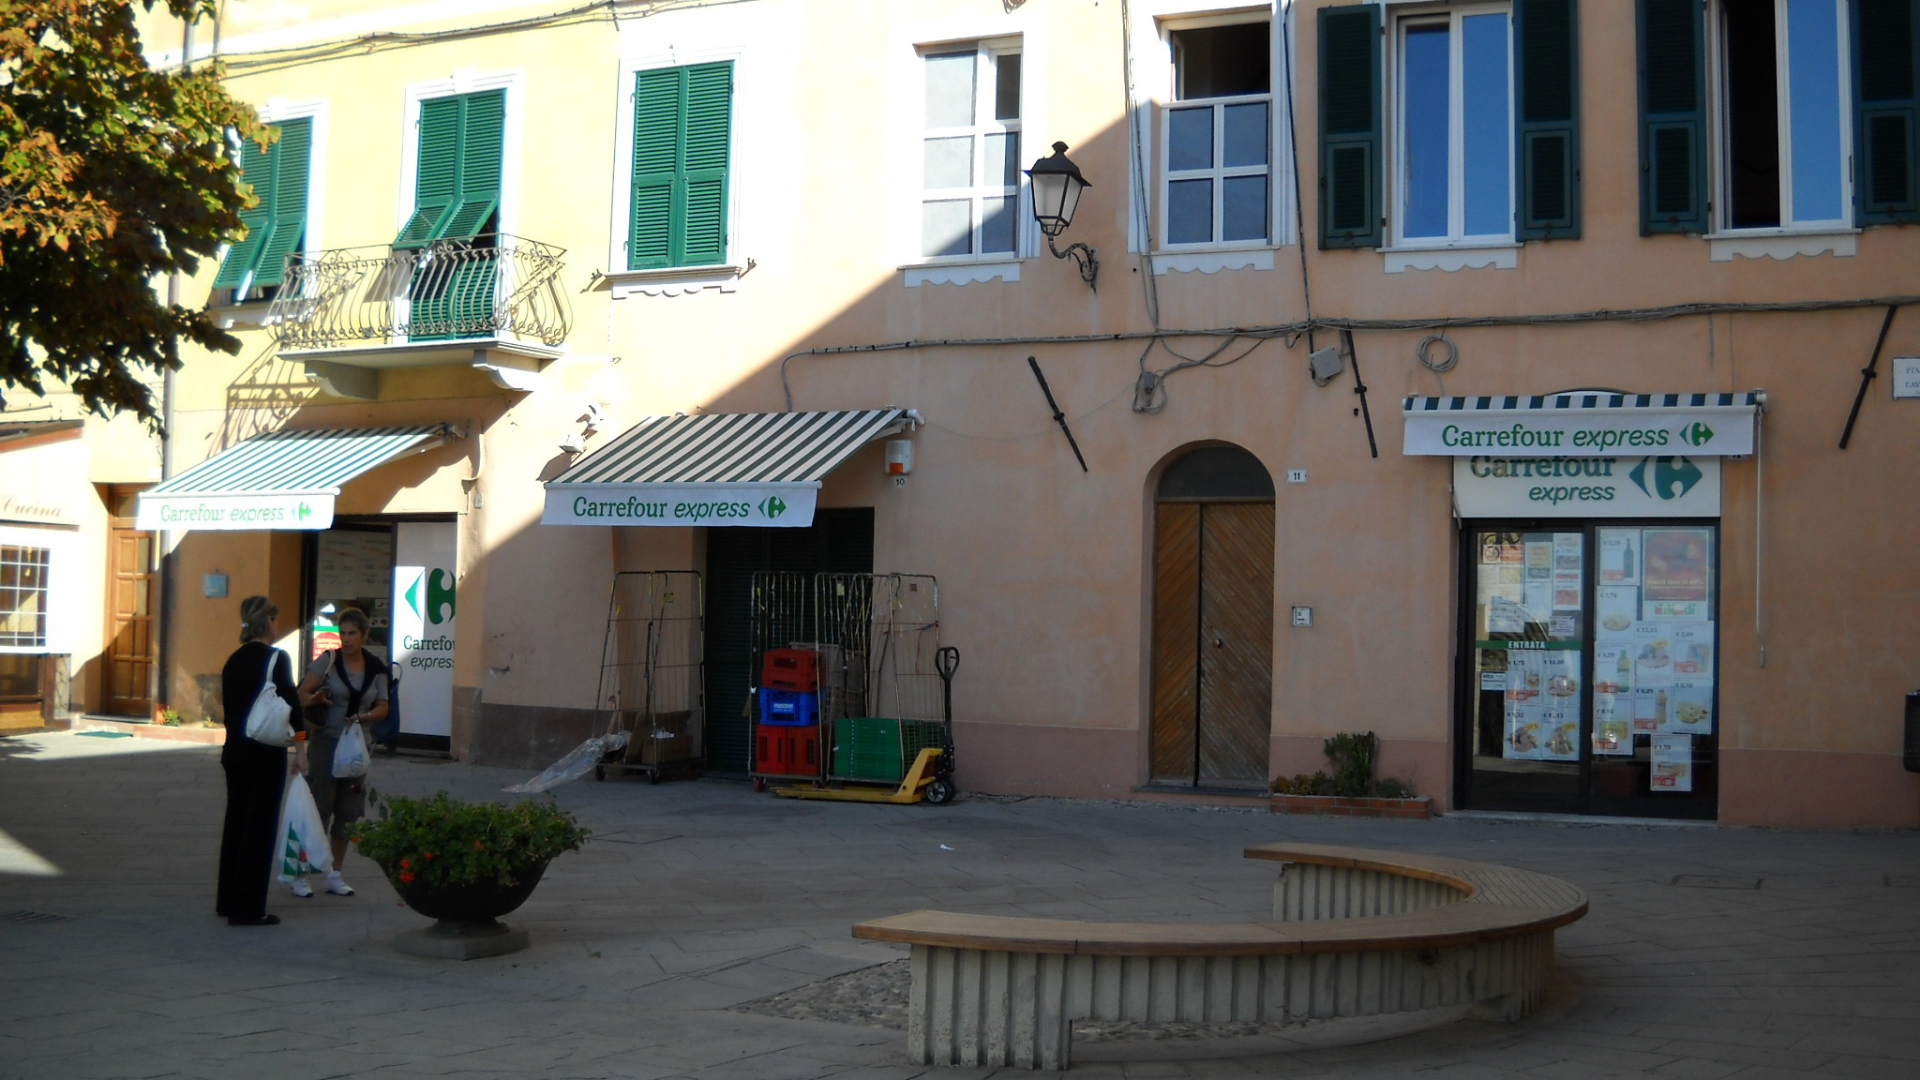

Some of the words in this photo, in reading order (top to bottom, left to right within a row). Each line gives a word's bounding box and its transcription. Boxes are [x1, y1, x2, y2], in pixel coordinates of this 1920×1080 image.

[1441, 423, 1564, 448] Carrefour
[1572, 428, 1669, 452] express
[1293, 471, 1301, 481] 11
[1469, 455, 1616, 478] Carrefour
[896, 477, 906, 487] 10
[1528, 483, 1615, 505] express
[1, 494, 62, 517] Cucina
[160, 503, 226, 522] Carrefour
[229, 506, 285, 523] express
[573, 496, 668, 518] Carrefour
[673, 500, 750, 523] express
[404, 634, 456, 651] Carrefo
[1508, 641, 1546, 649] ENTRATA
